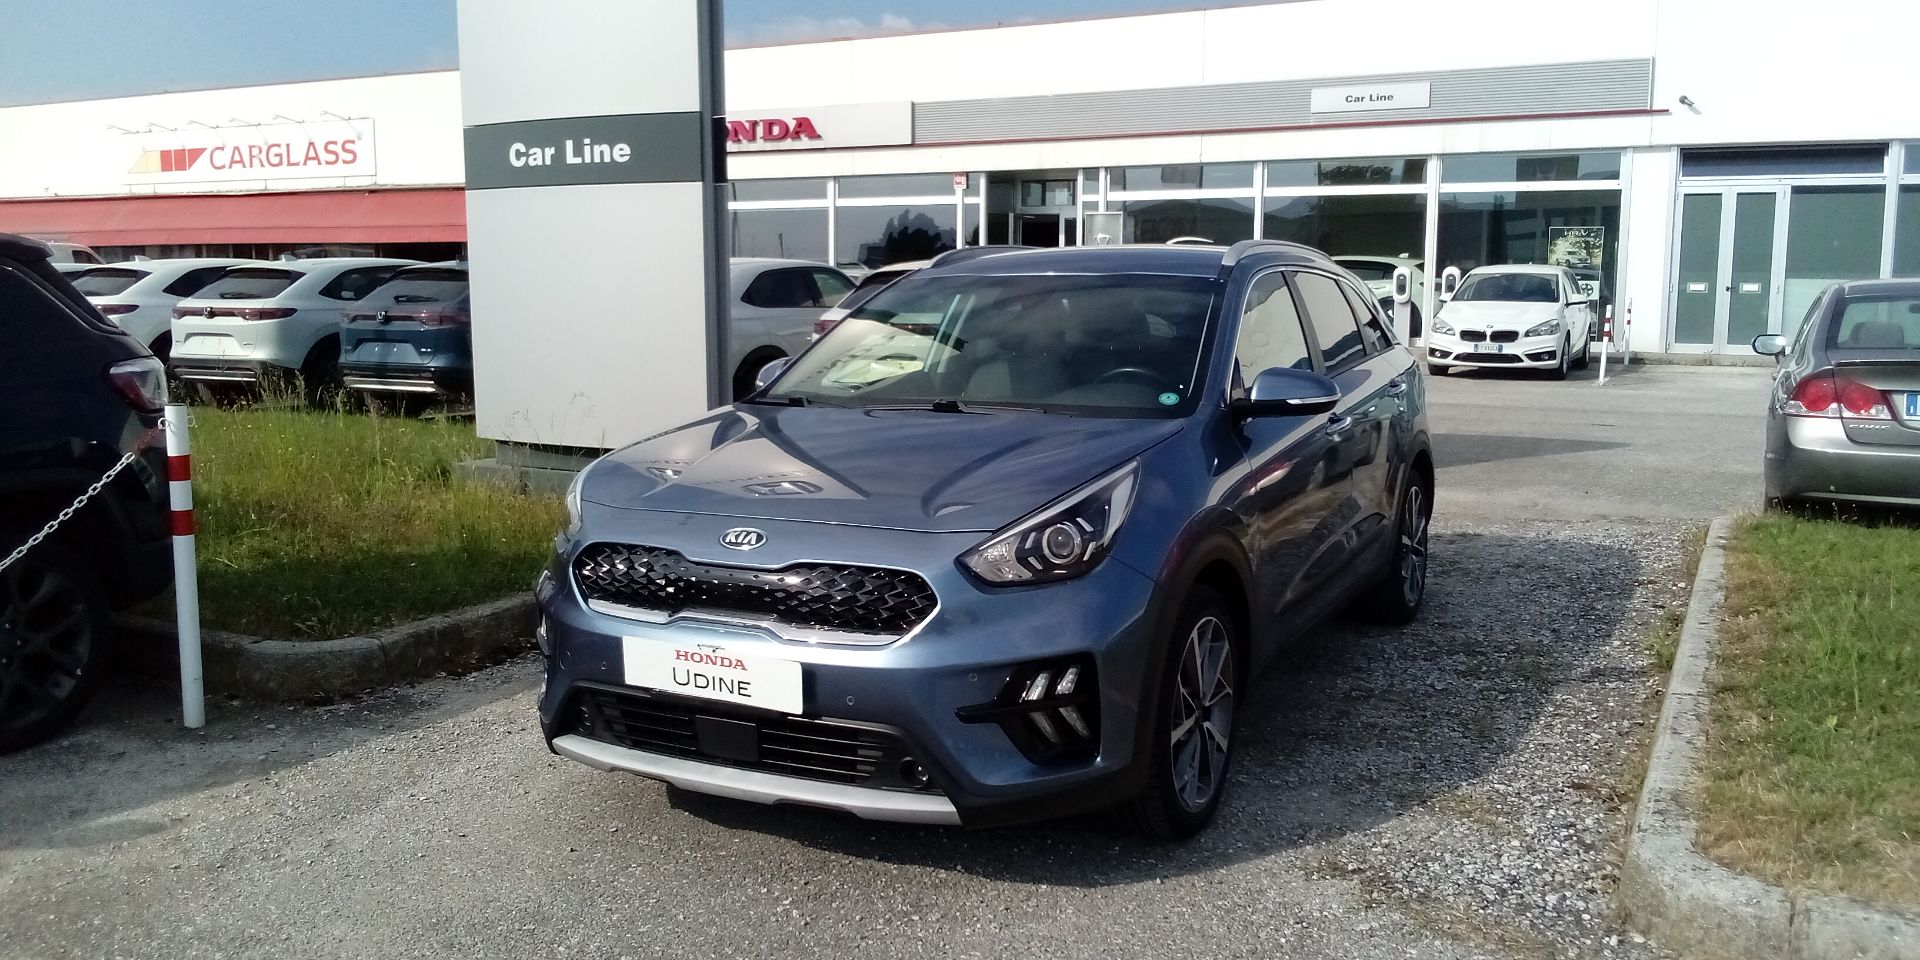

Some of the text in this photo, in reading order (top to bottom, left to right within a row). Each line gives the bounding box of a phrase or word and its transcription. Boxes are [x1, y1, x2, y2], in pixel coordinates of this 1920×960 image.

[1345, 94, 1394, 103] Car Line
[726, 117, 822, 143] NDA
[209, 140, 358, 170] CARGLASS
[509, 138, 631, 167] Car Line
[725, 531, 757, 545] KIA
[674, 649, 748, 671] HONDA
[673, 667, 752, 697] UDINE
